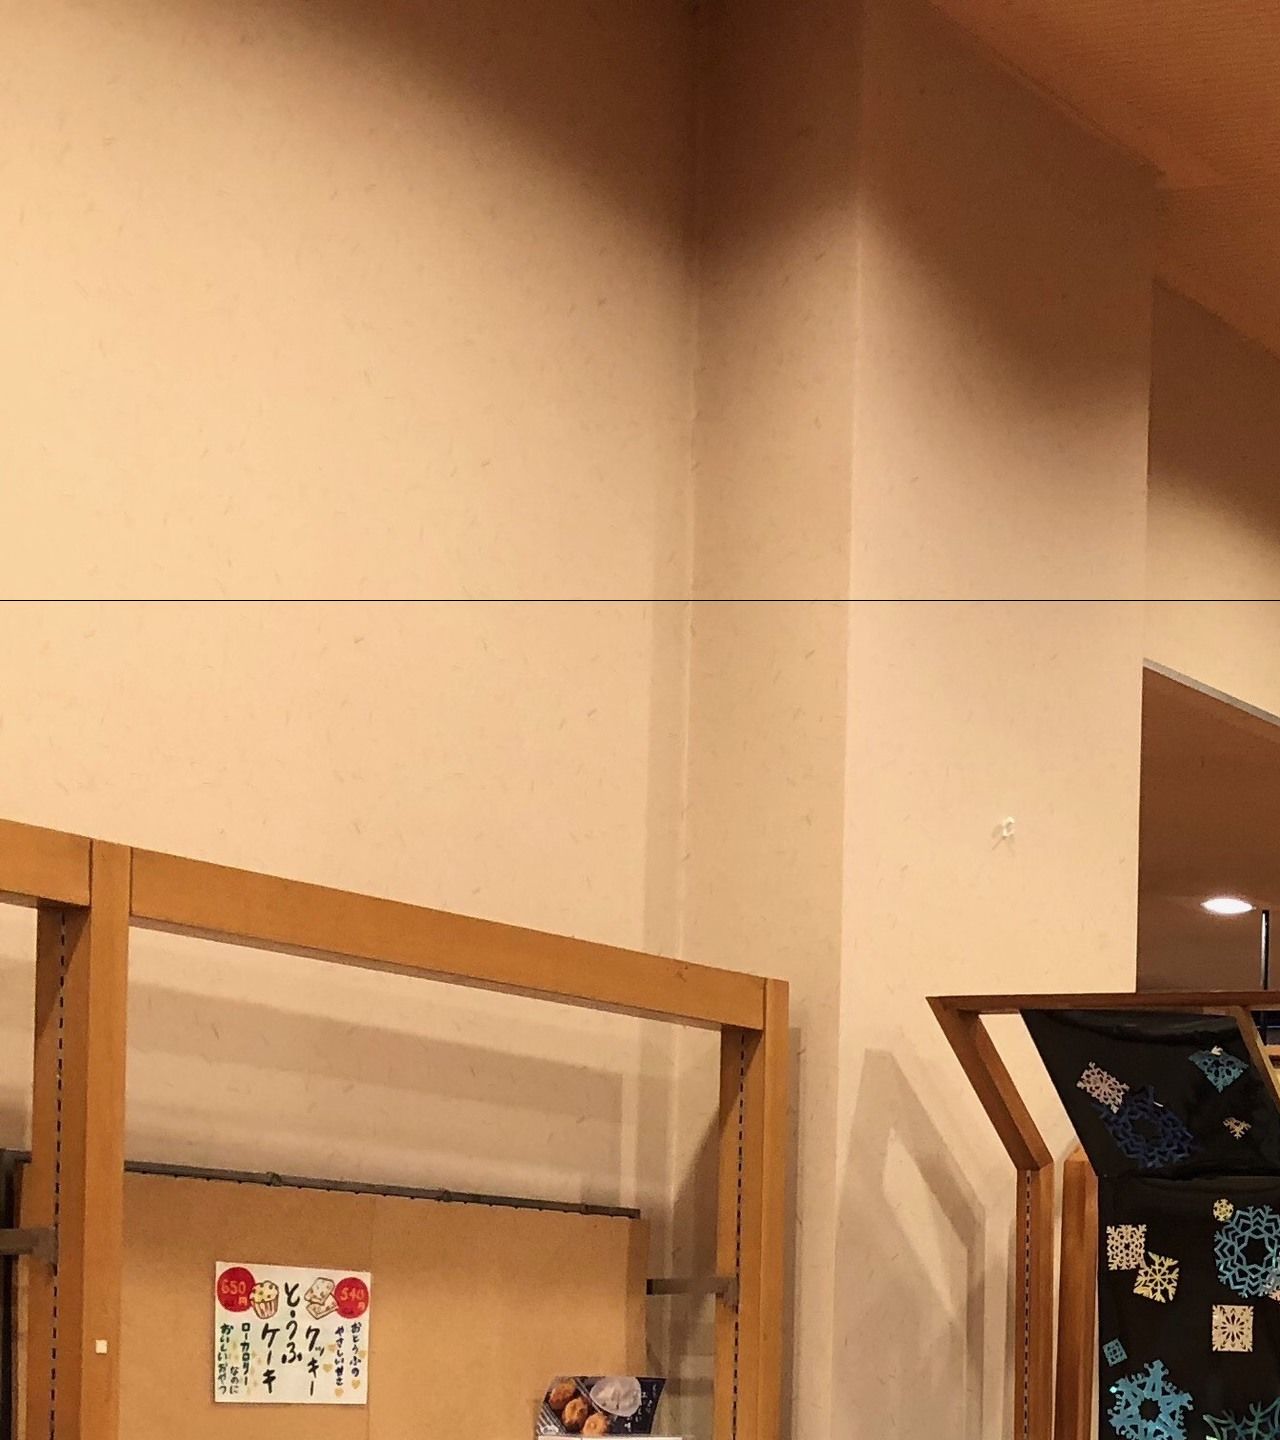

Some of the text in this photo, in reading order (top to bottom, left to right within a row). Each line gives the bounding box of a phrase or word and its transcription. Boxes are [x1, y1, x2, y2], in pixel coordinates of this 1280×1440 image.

[221, 1278, 247, 1295] 650
[340, 1287, 365, 1301] 540
[281, 1281, 303, 1364] とうふ
[349, 1321, 362, 1378] おとうふの
[229, 1366, 240, 1395] なのに
[240, 1322, 251, 1387] ローカロリー
[261, 1322, 281, 1395] ケーキ
[305, 1325, 325, 1397] クッキー
